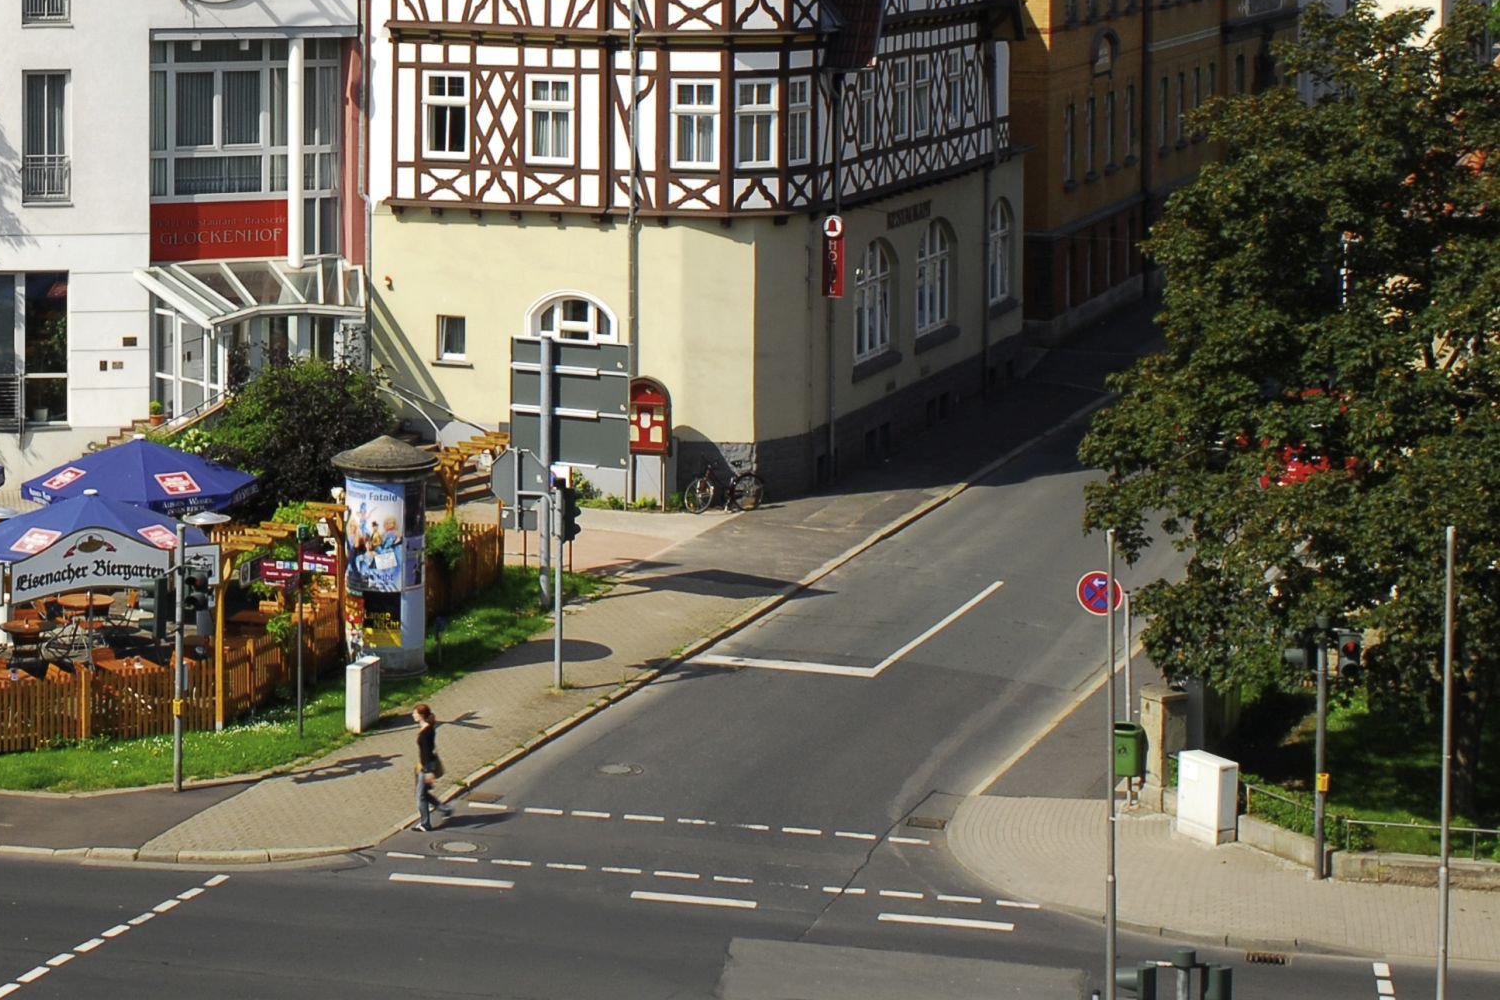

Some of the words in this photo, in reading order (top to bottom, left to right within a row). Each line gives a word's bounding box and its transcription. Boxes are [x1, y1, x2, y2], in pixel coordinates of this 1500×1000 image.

[160, 228, 284, 245] GLOCKENHOF
[15, 562, 88, 592] Eisenacher
[92, 559, 165, 581] Biergarten
